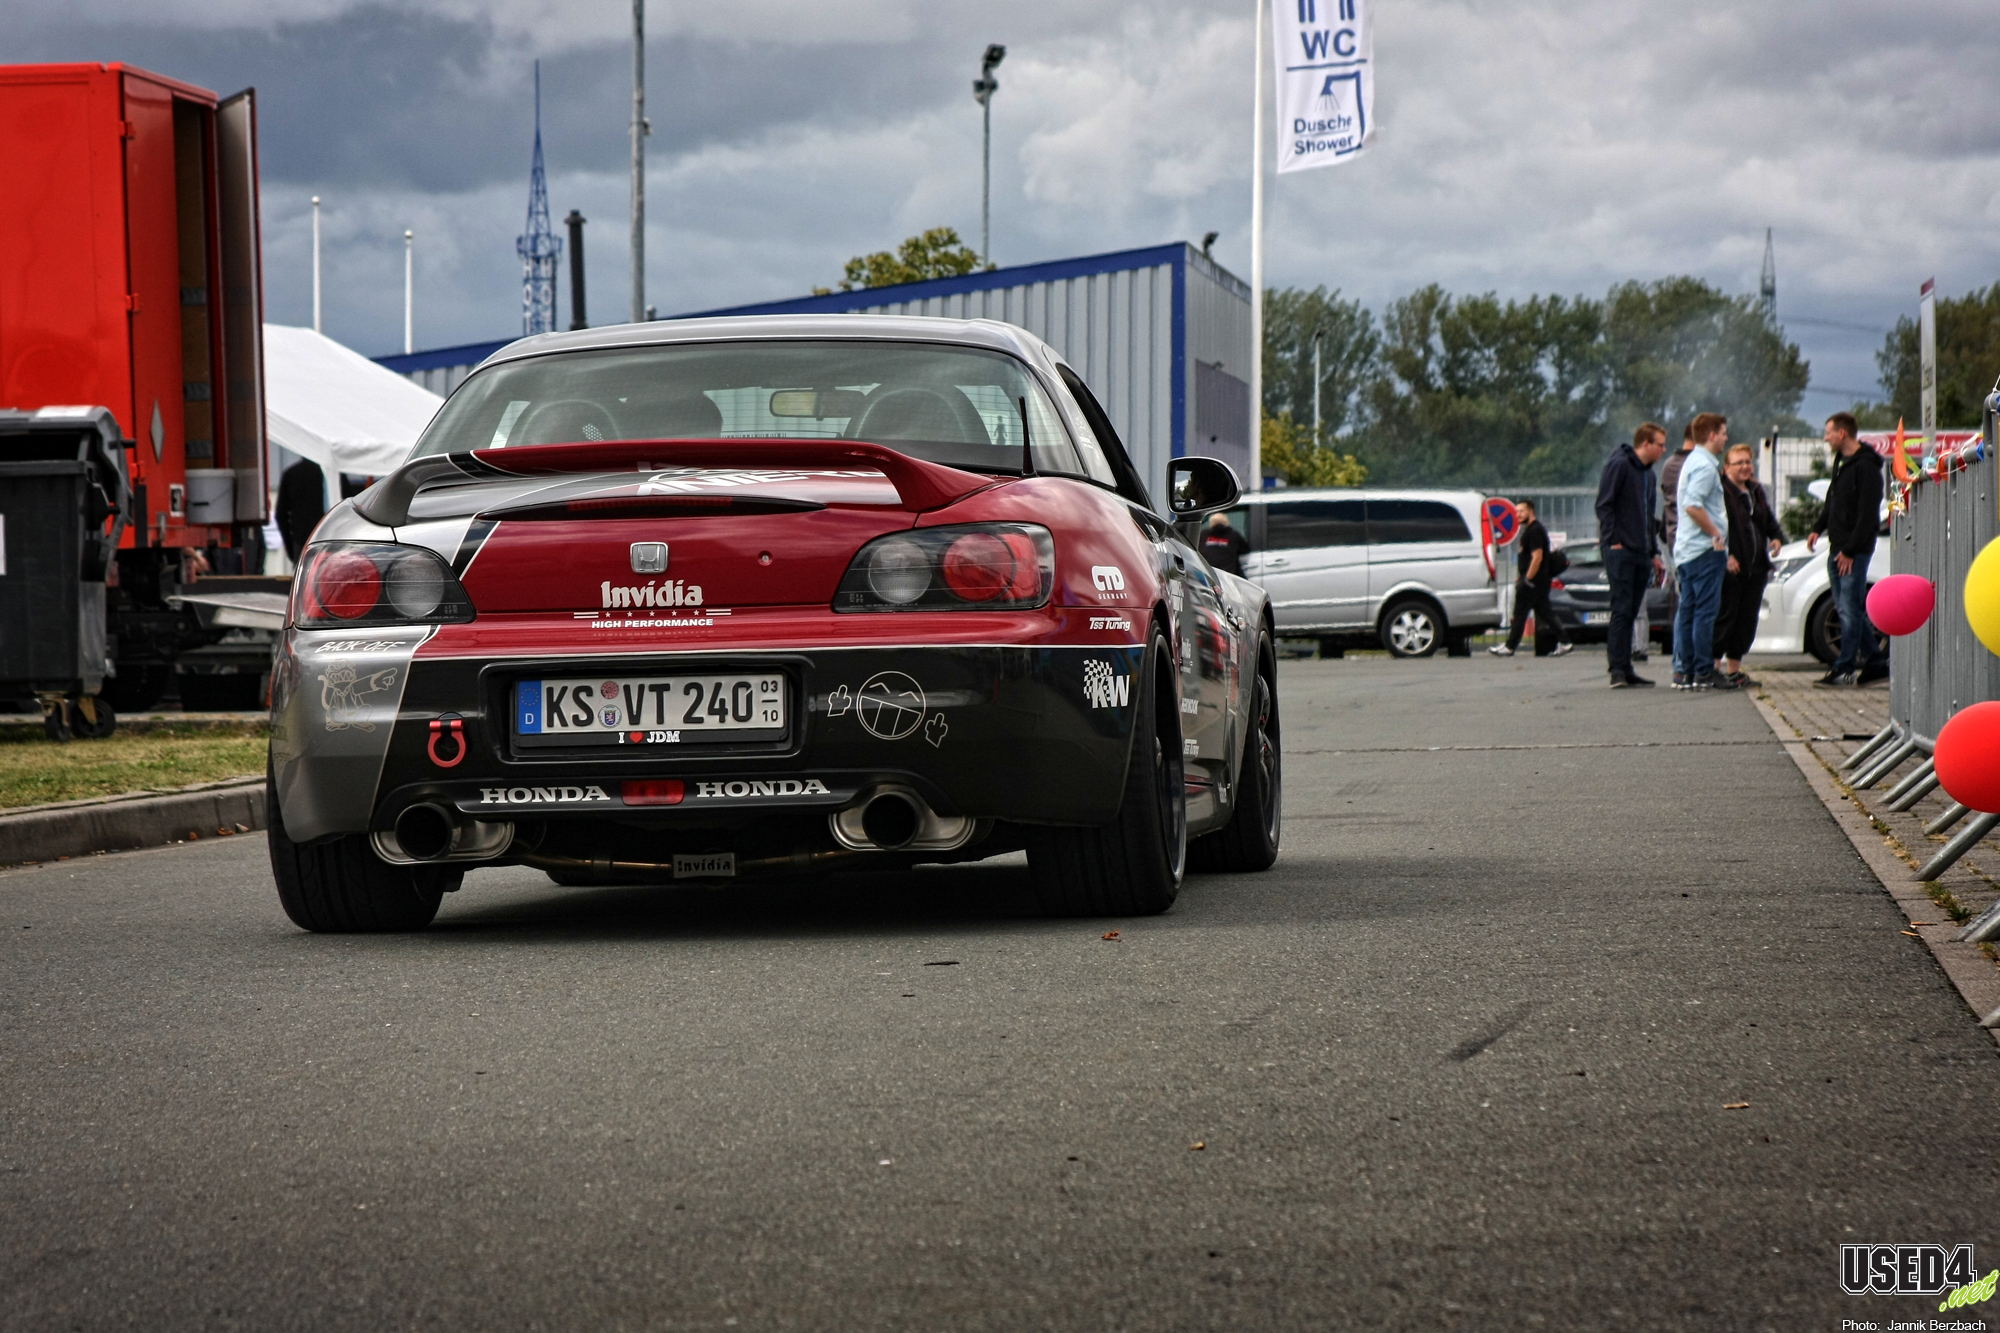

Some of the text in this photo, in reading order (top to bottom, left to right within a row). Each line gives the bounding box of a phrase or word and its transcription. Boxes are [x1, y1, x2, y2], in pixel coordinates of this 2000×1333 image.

[1301, 28, 1356, 60] WC
[1294, 135, 1354, 155] Shower
[600, 579, 704, 608] Invidia
[591, 619, 714, 629] HIGH PERFORMANCE
[1104, 617, 1131, 631] Tuning
[314, 641, 406, 653] BACK OFF
[761, 680, 779, 693] 03
[1091, 675, 1130, 709] KW
[525, 681, 753, 728] D KS VT 240
[762, 710, 779, 722] 10
[618, 731, 680, 744] I JDM
[480, 779, 831, 804] HONDA HONDA
[677, 858, 732, 873] Invidia
